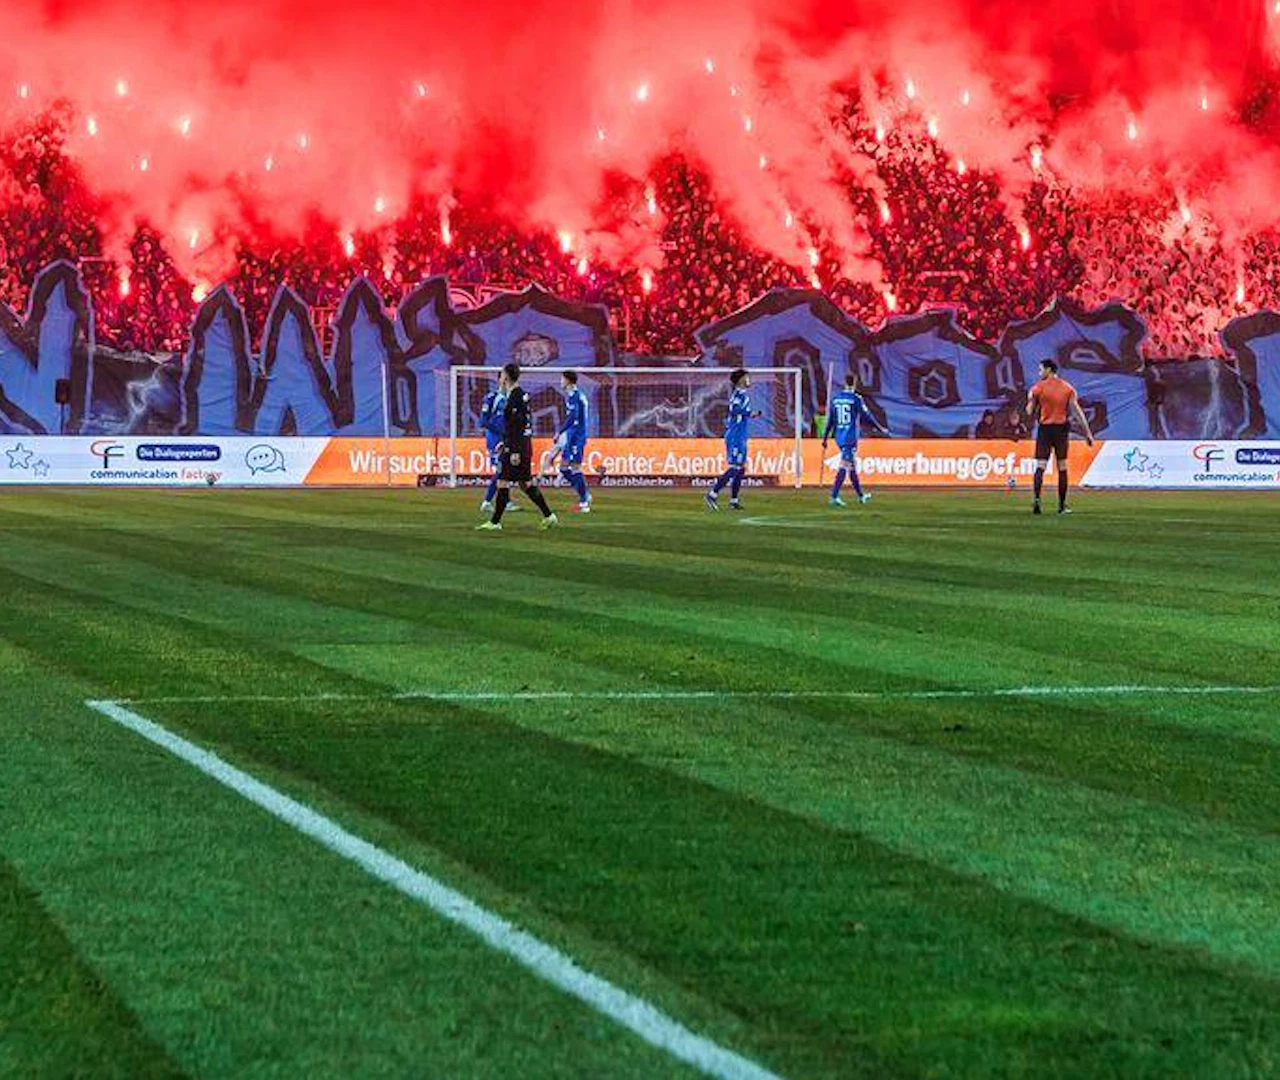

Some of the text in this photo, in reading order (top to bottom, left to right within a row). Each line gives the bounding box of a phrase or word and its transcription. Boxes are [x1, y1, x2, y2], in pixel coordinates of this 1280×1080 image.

[835, 404, 852, 425] 16
[349, 450, 385, 473] Wir
[389, 450, 465, 473] suchen
[90, 469, 178, 479] communication
[1193, 472, 1274, 481] communication
